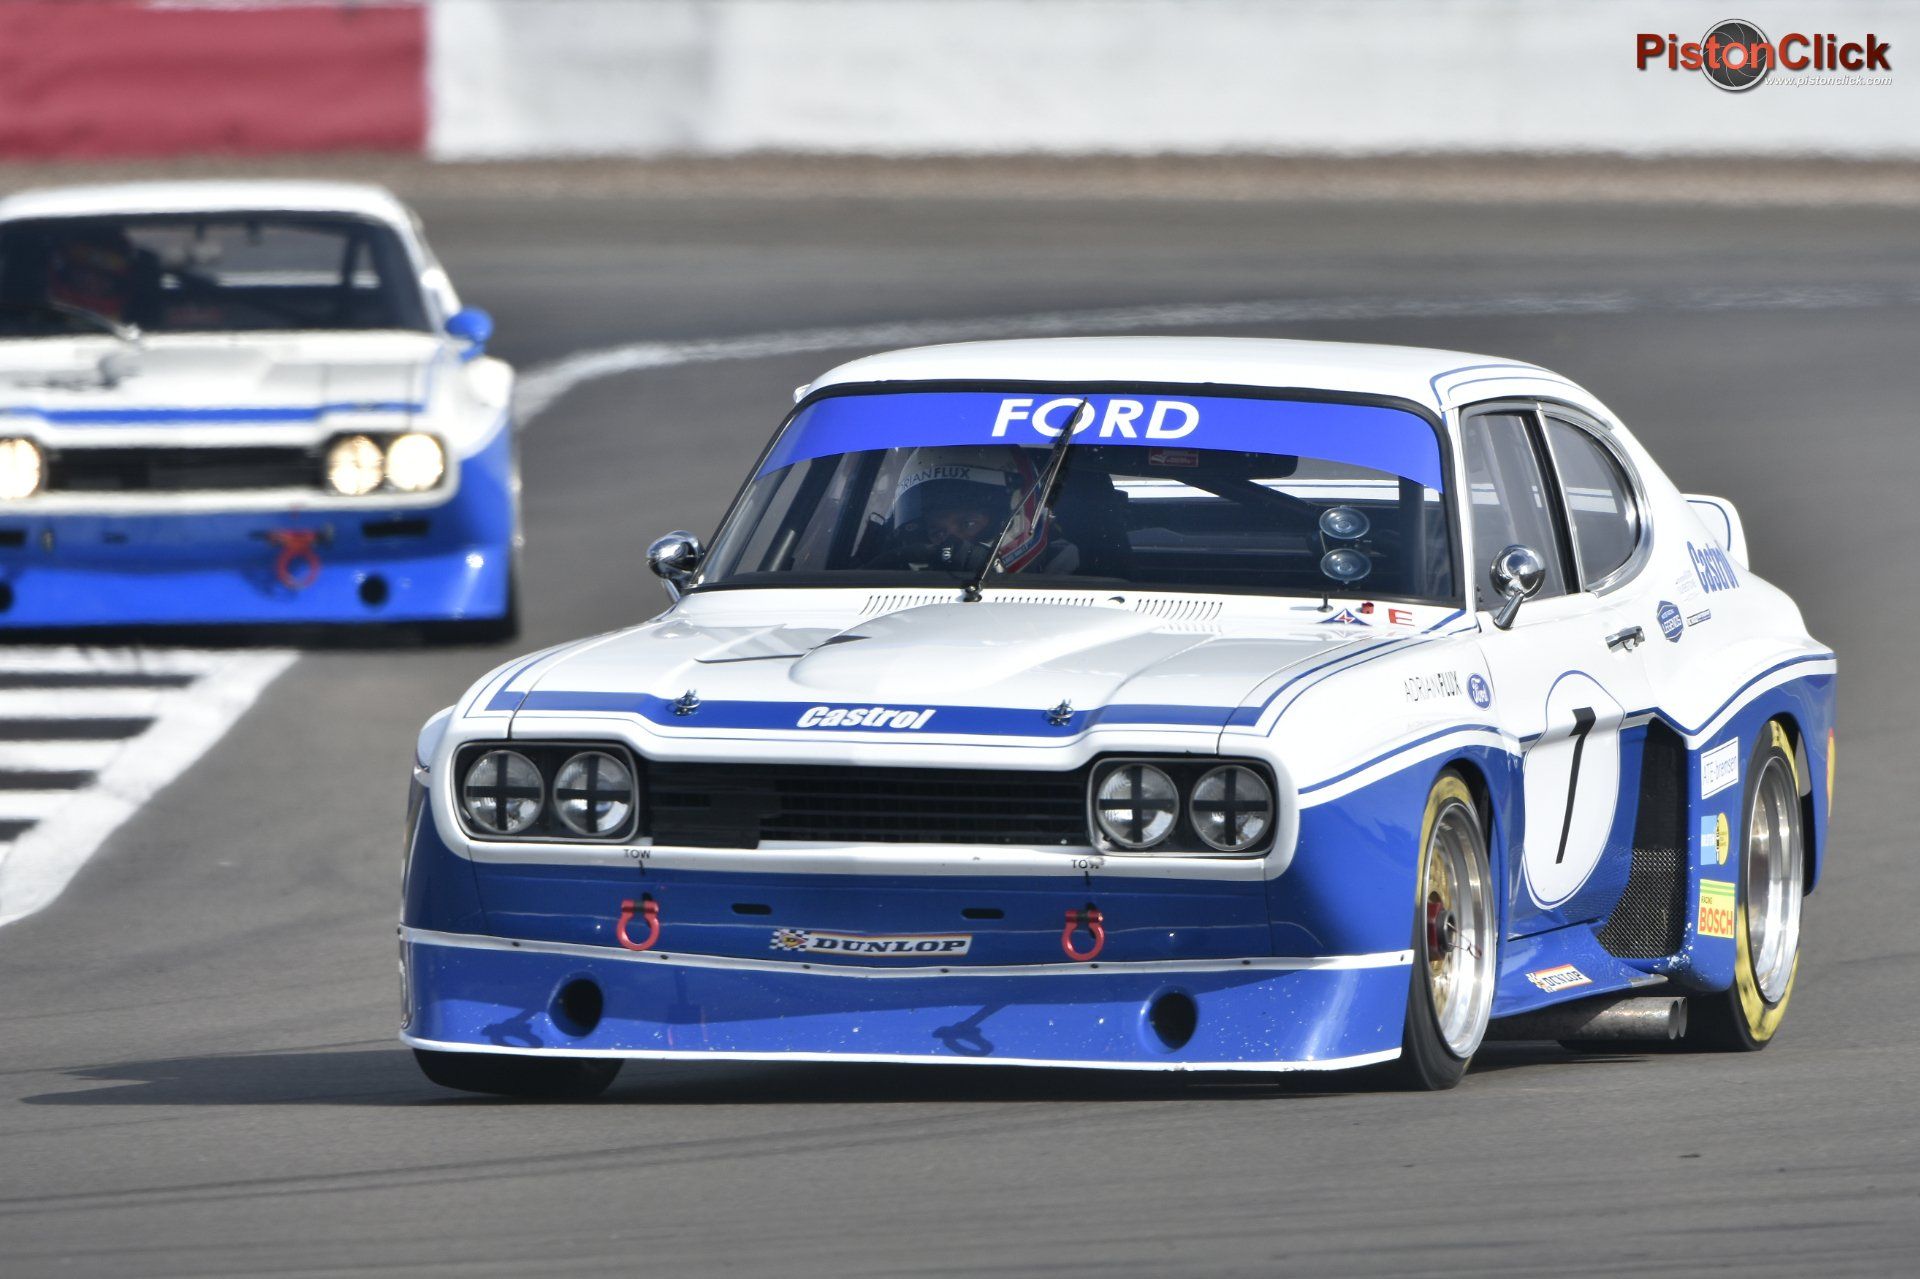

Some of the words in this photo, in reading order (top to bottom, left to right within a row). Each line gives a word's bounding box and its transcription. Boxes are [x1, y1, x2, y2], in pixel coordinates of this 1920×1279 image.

[991, 397, 1200, 439] FORD
[1388, 608, 1415, 626] E
[796, 706, 937, 730] Castrol
[1556, 706, 1597, 864] 7
[623, 848, 651, 859] TOW
[1699, 906, 1733, 935] BOSCH
[813, 937, 966, 953] DUNLOP
